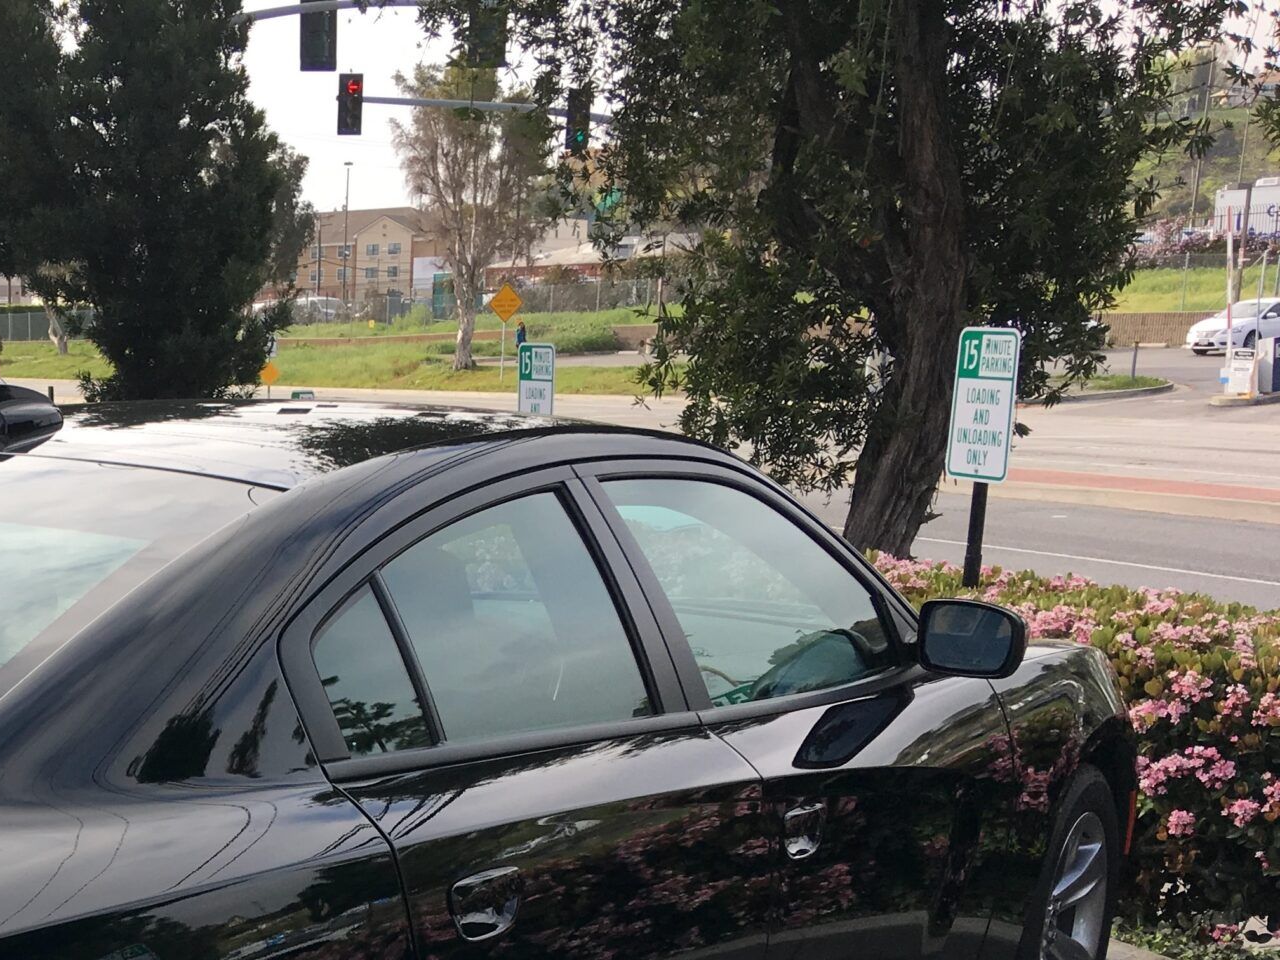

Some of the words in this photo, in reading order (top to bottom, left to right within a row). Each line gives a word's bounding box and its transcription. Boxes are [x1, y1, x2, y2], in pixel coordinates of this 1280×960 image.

[963, 339, 979, 370] 15
[985, 338, 1012, 356] MINUTE
[521, 351, 531, 374] 15
[981, 356, 1013, 374] PARKING
[966, 389, 1000, 406] LOADING
[972, 409, 990, 425] AND
[956, 428, 1003, 447] UNLOADING
[966, 448, 989, 466] ONLY
